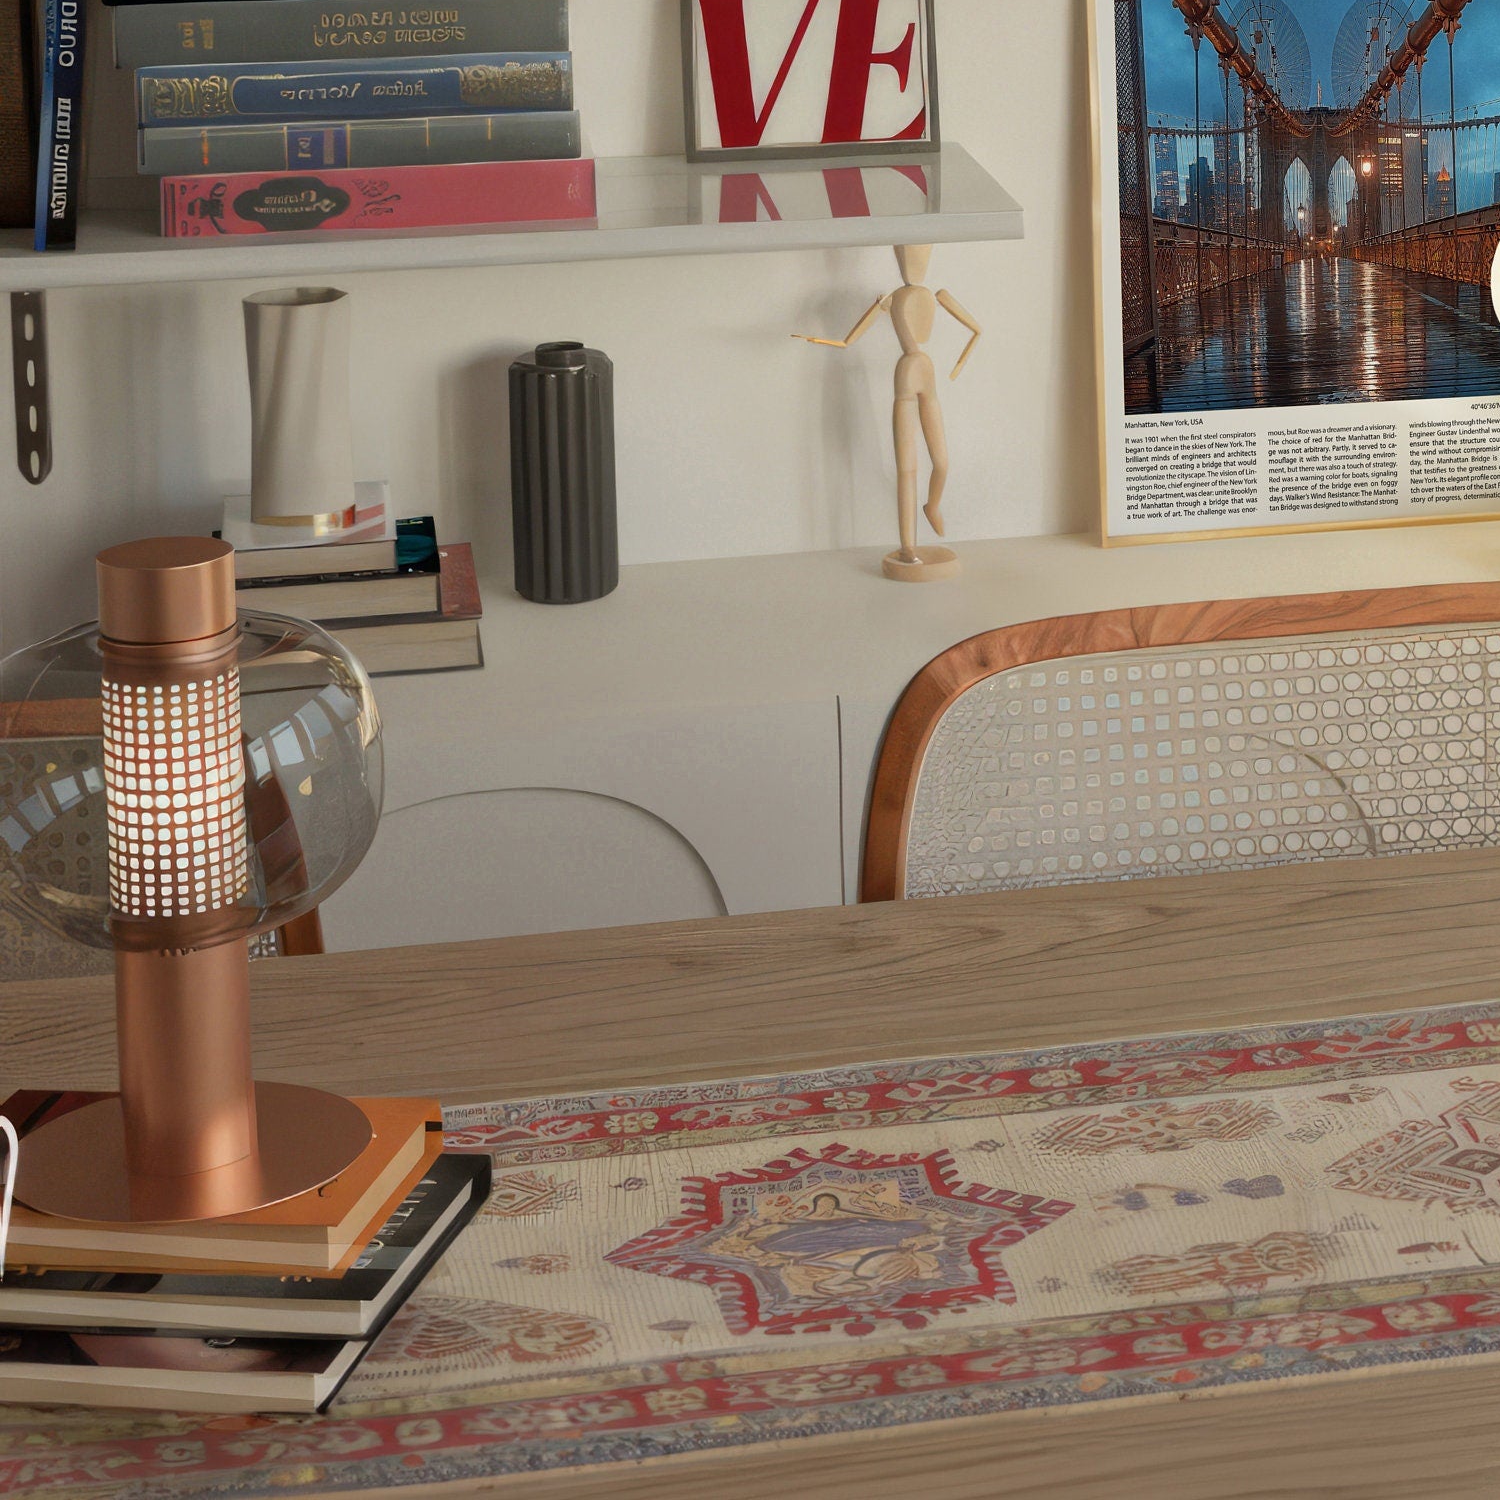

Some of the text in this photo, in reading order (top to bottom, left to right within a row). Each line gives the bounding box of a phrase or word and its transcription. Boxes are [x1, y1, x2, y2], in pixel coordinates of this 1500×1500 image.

[1124, 421, 1159, 429] Manhattan,
[1174, 419, 1189, 427] York,
[1427, 420, 1451, 428] blowing
[1451, 418, 1475, 427] through
[1219, 430, 1256, 440] conspirators
[1409, 430, 1435, 438] Engineer
[1125, 446, 1144, 454] began
[1181, 451, 1211, 461] engineers
[1125, 464, 1157, 473] converged
[1169, 462, 1194, 471] creating
[1201, 460, 1221, 469] bridge
[1268, 466, 1286, 474] ment,
[1372, 460, 1398, 469] strategy.
[1125, 473, 1165, 481] revolutionize
[1177, 471, 1206, 480] cityscape.
[1125, 483, 1152, 492] vingston
[1153, 482, 1166, 490] Roe,
[1183, 480, 1210, 489] engineer
[1126, 493, 1146, 501] Bridge
[1146, 491, 1185, 500] Department,
[1230, 487, 1257, 496] Brooklyn
[1410, 495, 1425, 503] story
[1435, 494, 1461, 502] progress,
[1140, 501, 1173, 509] Manhattan
[1175, 499, 1200, 508] through
[1208, 498, 1229, 506] bridge
[1196, 507, 1226, 516] challenge
